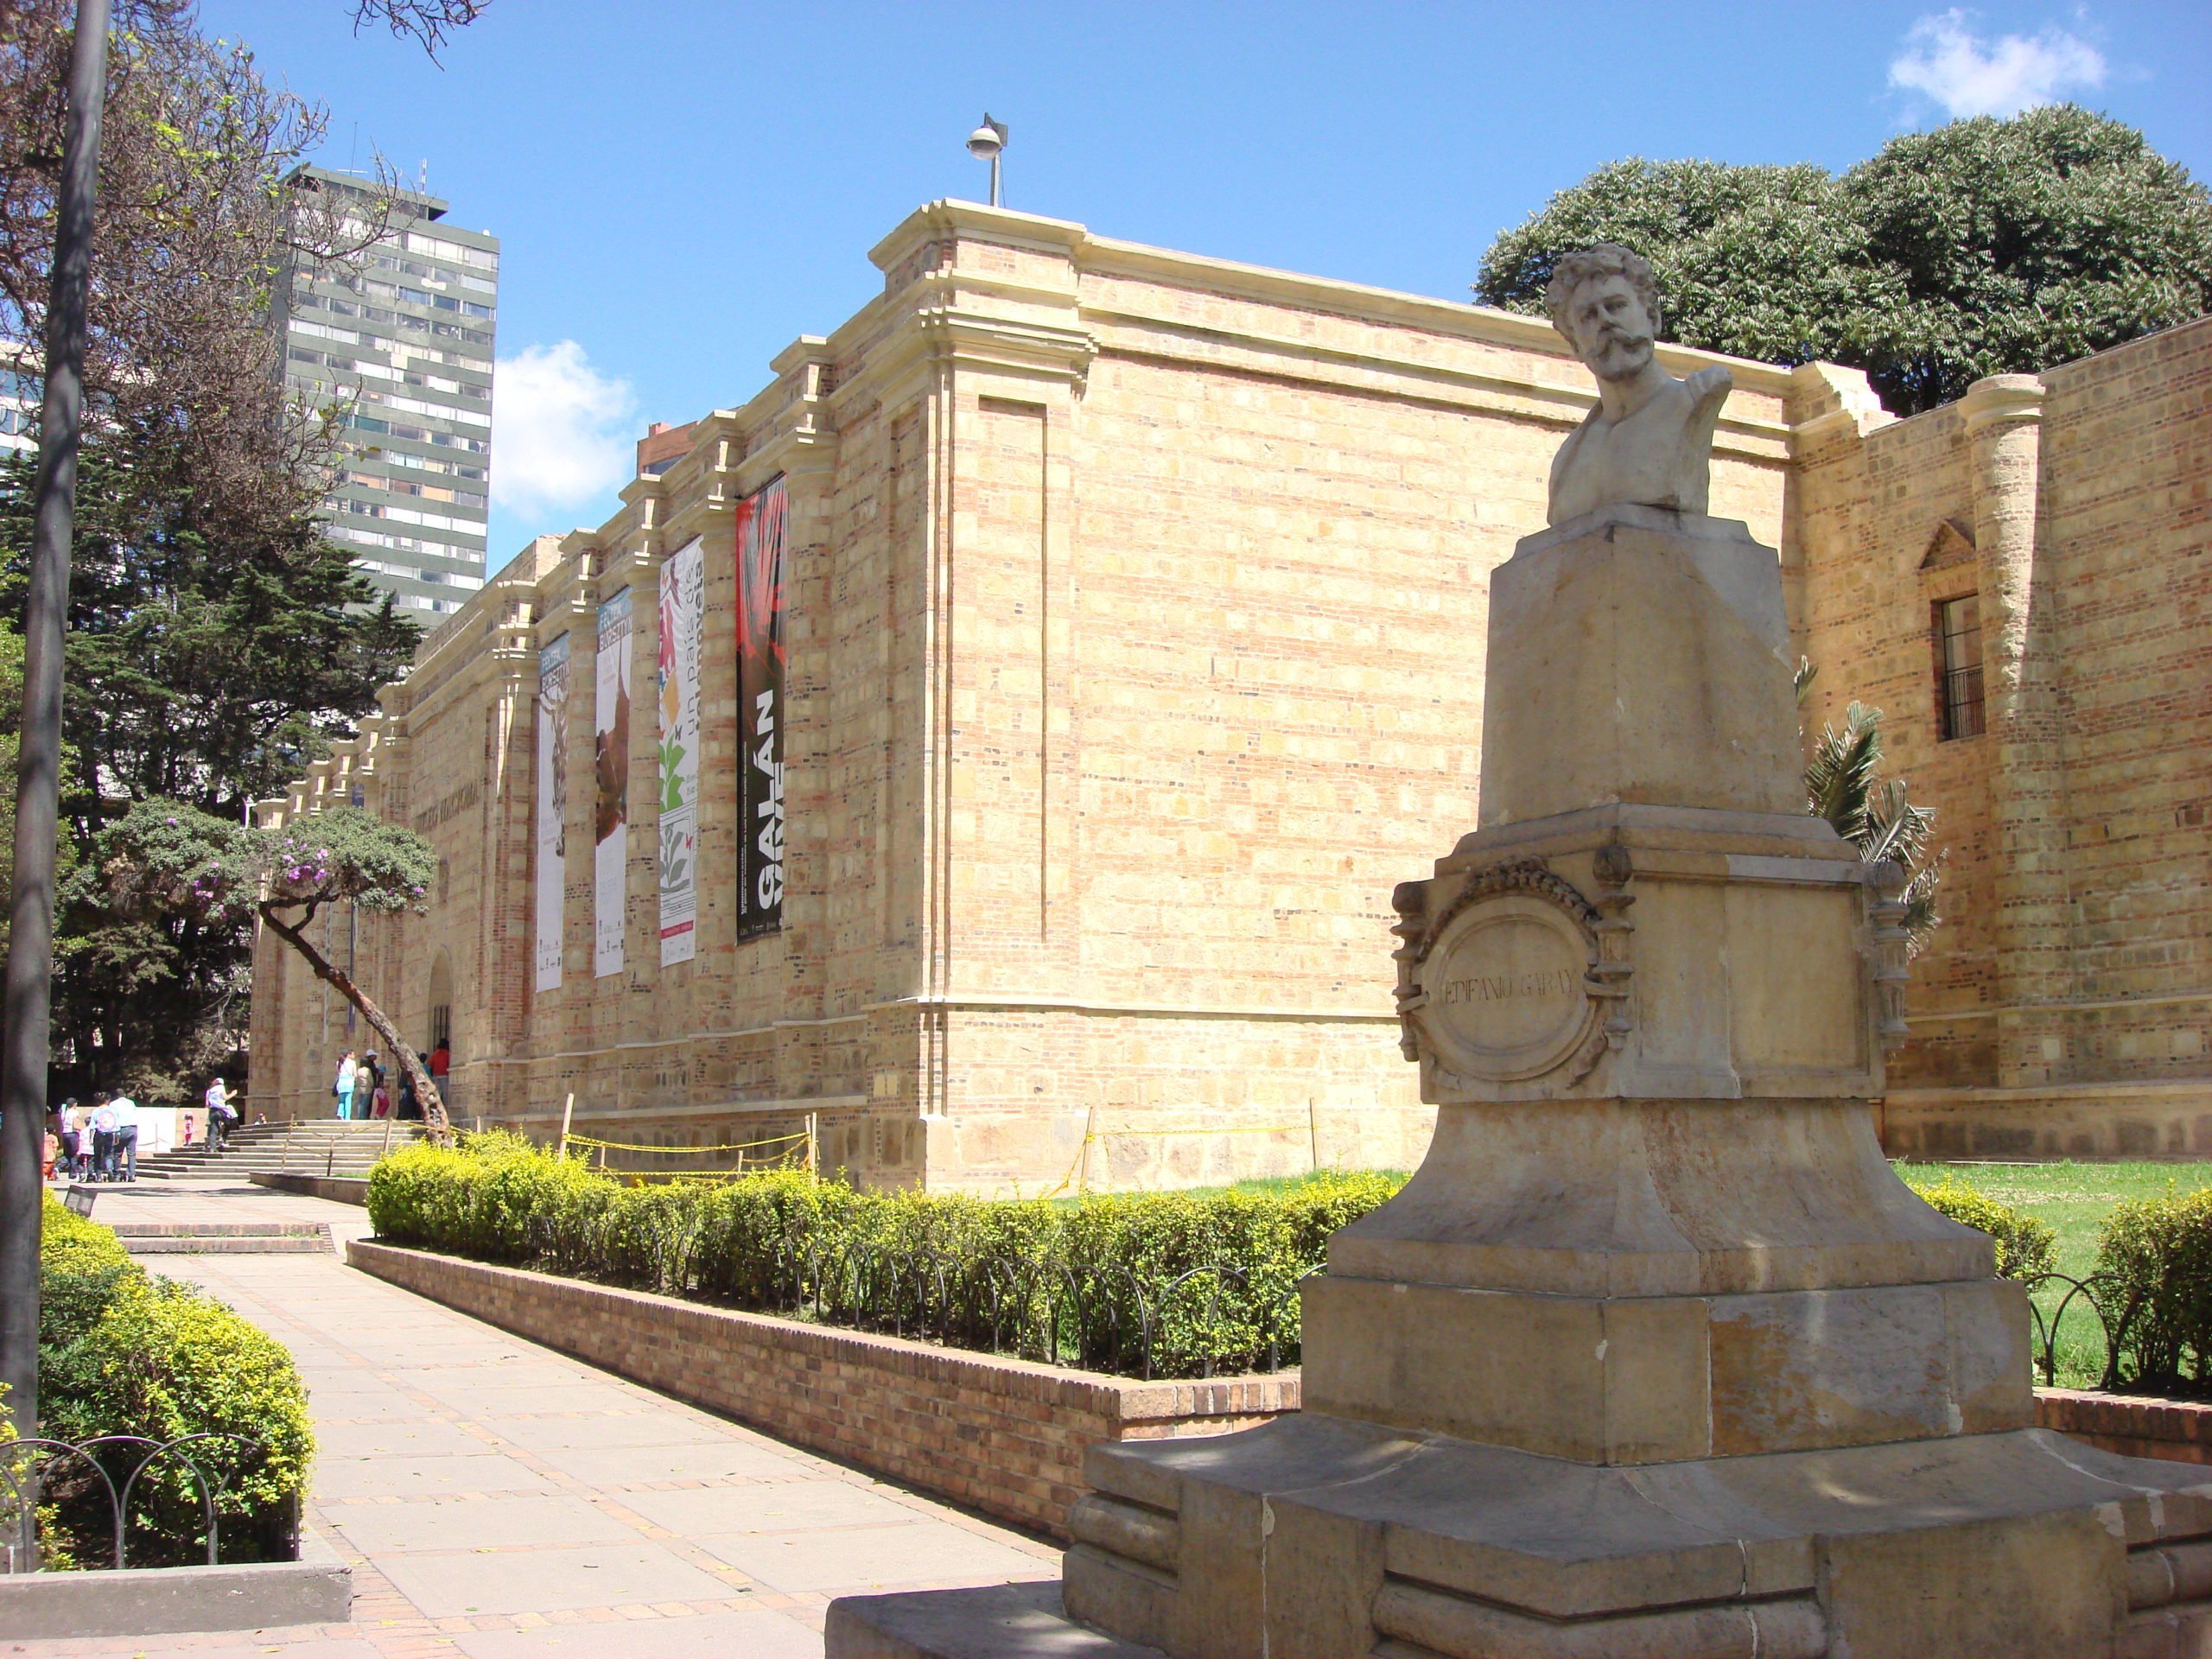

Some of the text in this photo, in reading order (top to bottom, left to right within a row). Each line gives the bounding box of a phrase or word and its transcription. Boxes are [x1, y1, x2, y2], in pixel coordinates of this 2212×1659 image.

[599, 614, 633, 651] BURSZTYN
[684, 567, 698, 736] un país de
[753, 689, 776, 910] GALÁN
[1445, 969, 1574, 1004] EPIFANIO GARAY
